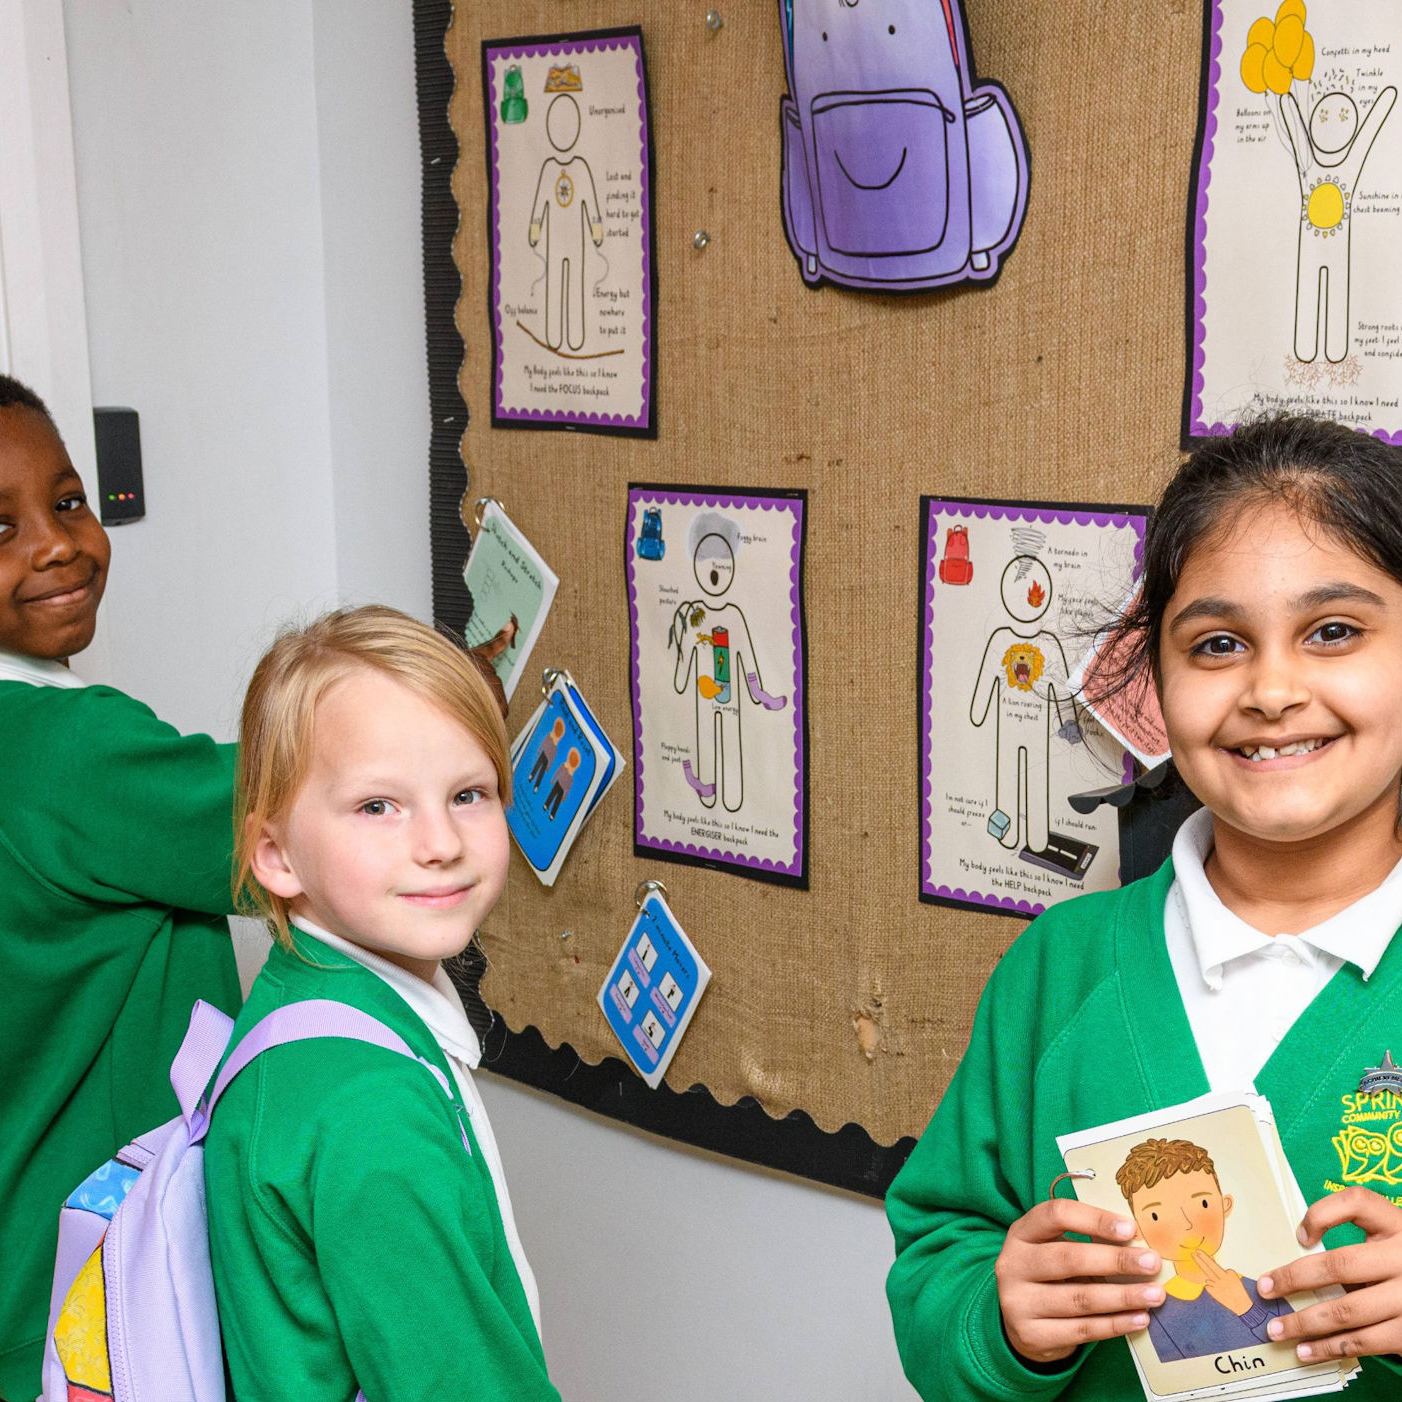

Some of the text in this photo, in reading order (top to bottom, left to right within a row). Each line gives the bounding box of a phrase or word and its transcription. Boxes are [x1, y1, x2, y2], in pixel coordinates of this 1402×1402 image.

[1322, 47, 1349, 57] Confetti
[1362, 47, 1371, 57] my
[1374, 45, 1390, 53] head
[1356, 69, 1383, 77] Twinkle
[1358, 83, 1377, 93] in my
[1360, 98, 1374, 107] eyes
[1237, 109, 1261, 117] Balloons
[1263, 123, 1269, 131] up
[1359, 192, 1389, 200] Sunshine
[1353, 205, 1370, 213] chest
[1373, 206, 1400, 215] beaming
[596, 288, 629, 302] Energy but
[608, 327, 618, 337] put
[1358, 322, 1379, 333] Strong
[1354, 338, 1363, 346] my
[1386, 336, 1399, 346] feel
[524, 366, 532, 378] My
[548, 384, 558, 393] the
[560, 384, 581, 394] FOCUS
[1254, 394, 1264, 406] My
[1323, 396, 1337, 404] this
[1355, 398, 1373, 406] know
[1381, 399, 1398, 407] need
[1340, 410, 1372, 421] backpack
[1054, 549, 1079, 557] tornado
[1054, 562, 1062, 571] my
[1022, 703, 1042, 712] roaring
[1015, 713, 1022, 722] my
[1024, 712, 1038, 721] chest
[955, 795, 963, 803] not
[949, 806, 965, 815] should
[664, 810, 672, 821] My
[673, 813, 685, 824] body
[770, 830, 779, 838] the
[1066, 819, 1083, 828] should
[691, 827, 748, 846] ENERGISER backpack
[960, 858, 969, 871] My
[971, 860, 986, 874] body
[988, 865, 1004, 875] feels
[1006, 866, 1017, 876] like
[1020, 870, 1033, 880] this
[1047, 874, 1063, 885] know
[1069, 881, 1084, 890] need
[992, 879, 1052, 897] the HELP backpack
[1342, 1111, 1400, 1123] COMMUNITY
[1324, 1179, 1347, 1192] INSP
[1213, 1355, 1265, 1376] Chin
